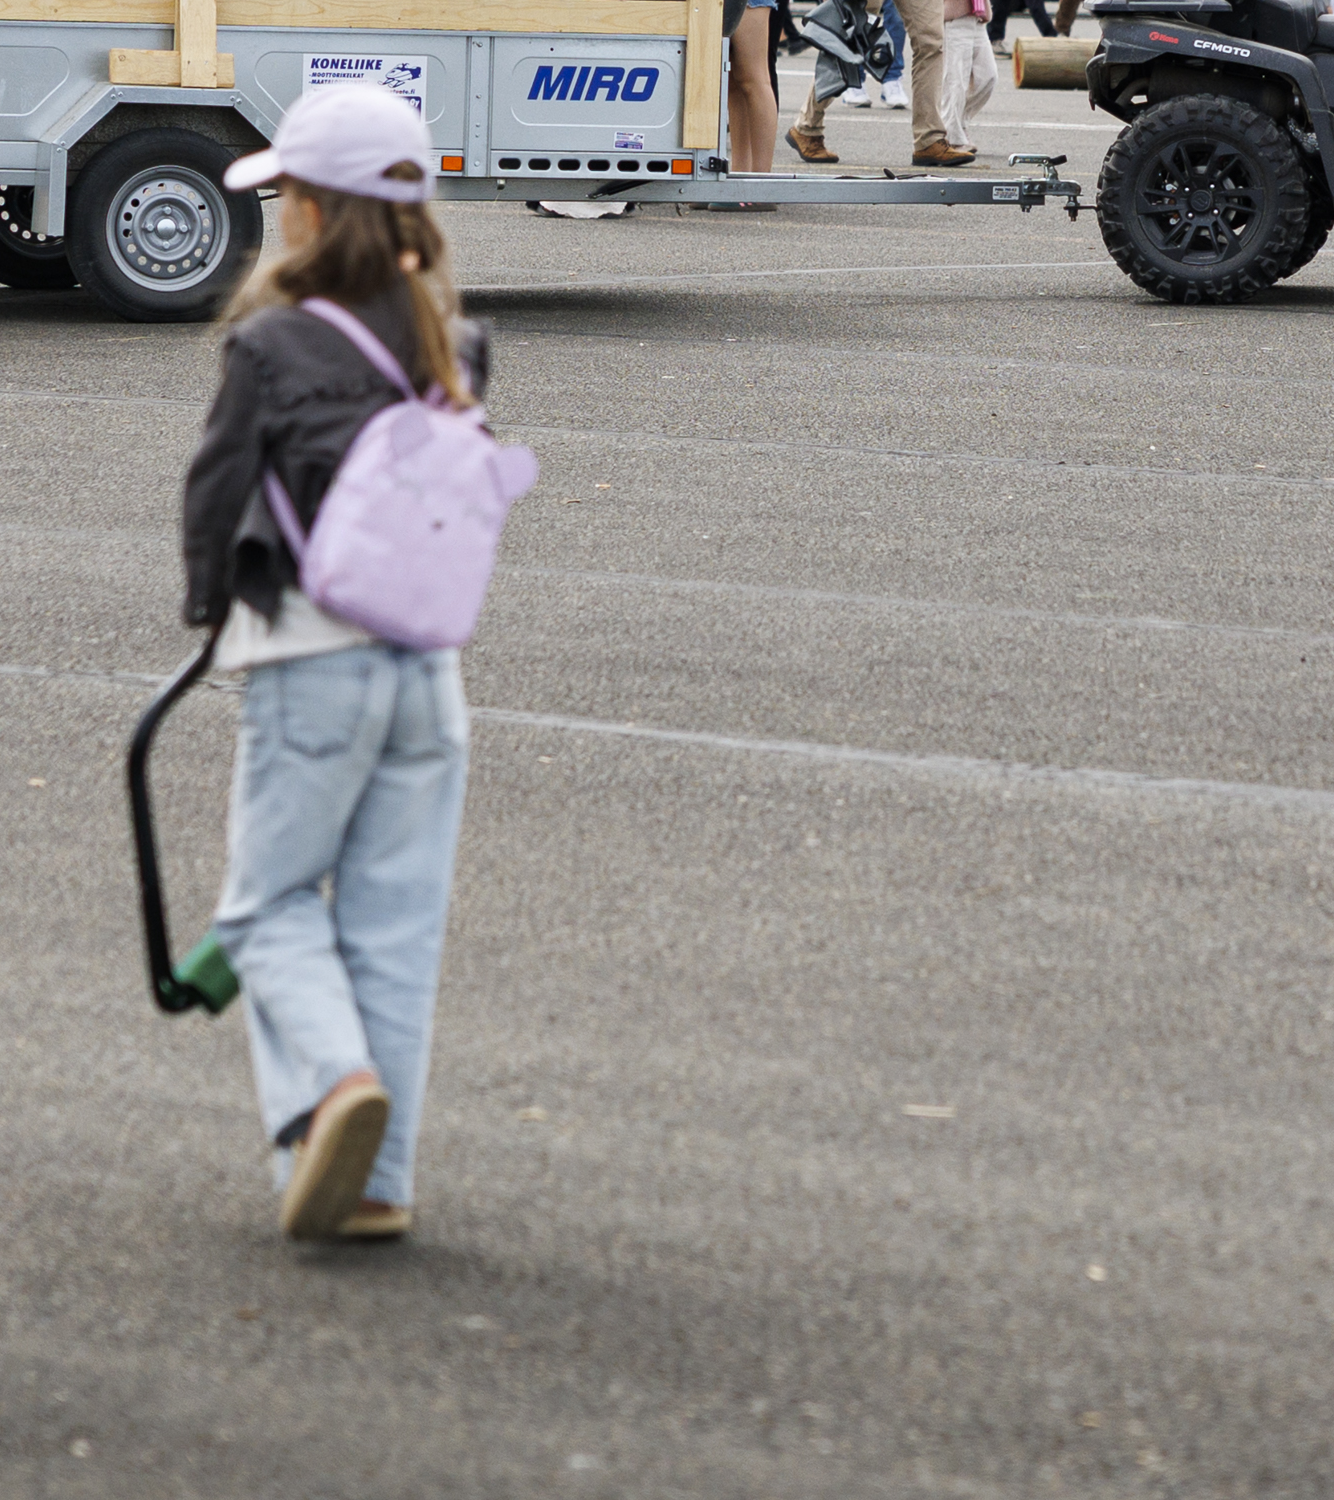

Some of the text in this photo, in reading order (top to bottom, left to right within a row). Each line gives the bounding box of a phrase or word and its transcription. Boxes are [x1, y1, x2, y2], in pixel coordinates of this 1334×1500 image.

[1193, 39, 1251, 58] CFMOTO
[310, 58, 383, 71] KONELIIKE
[527, 65, 660, 102] MIRO
